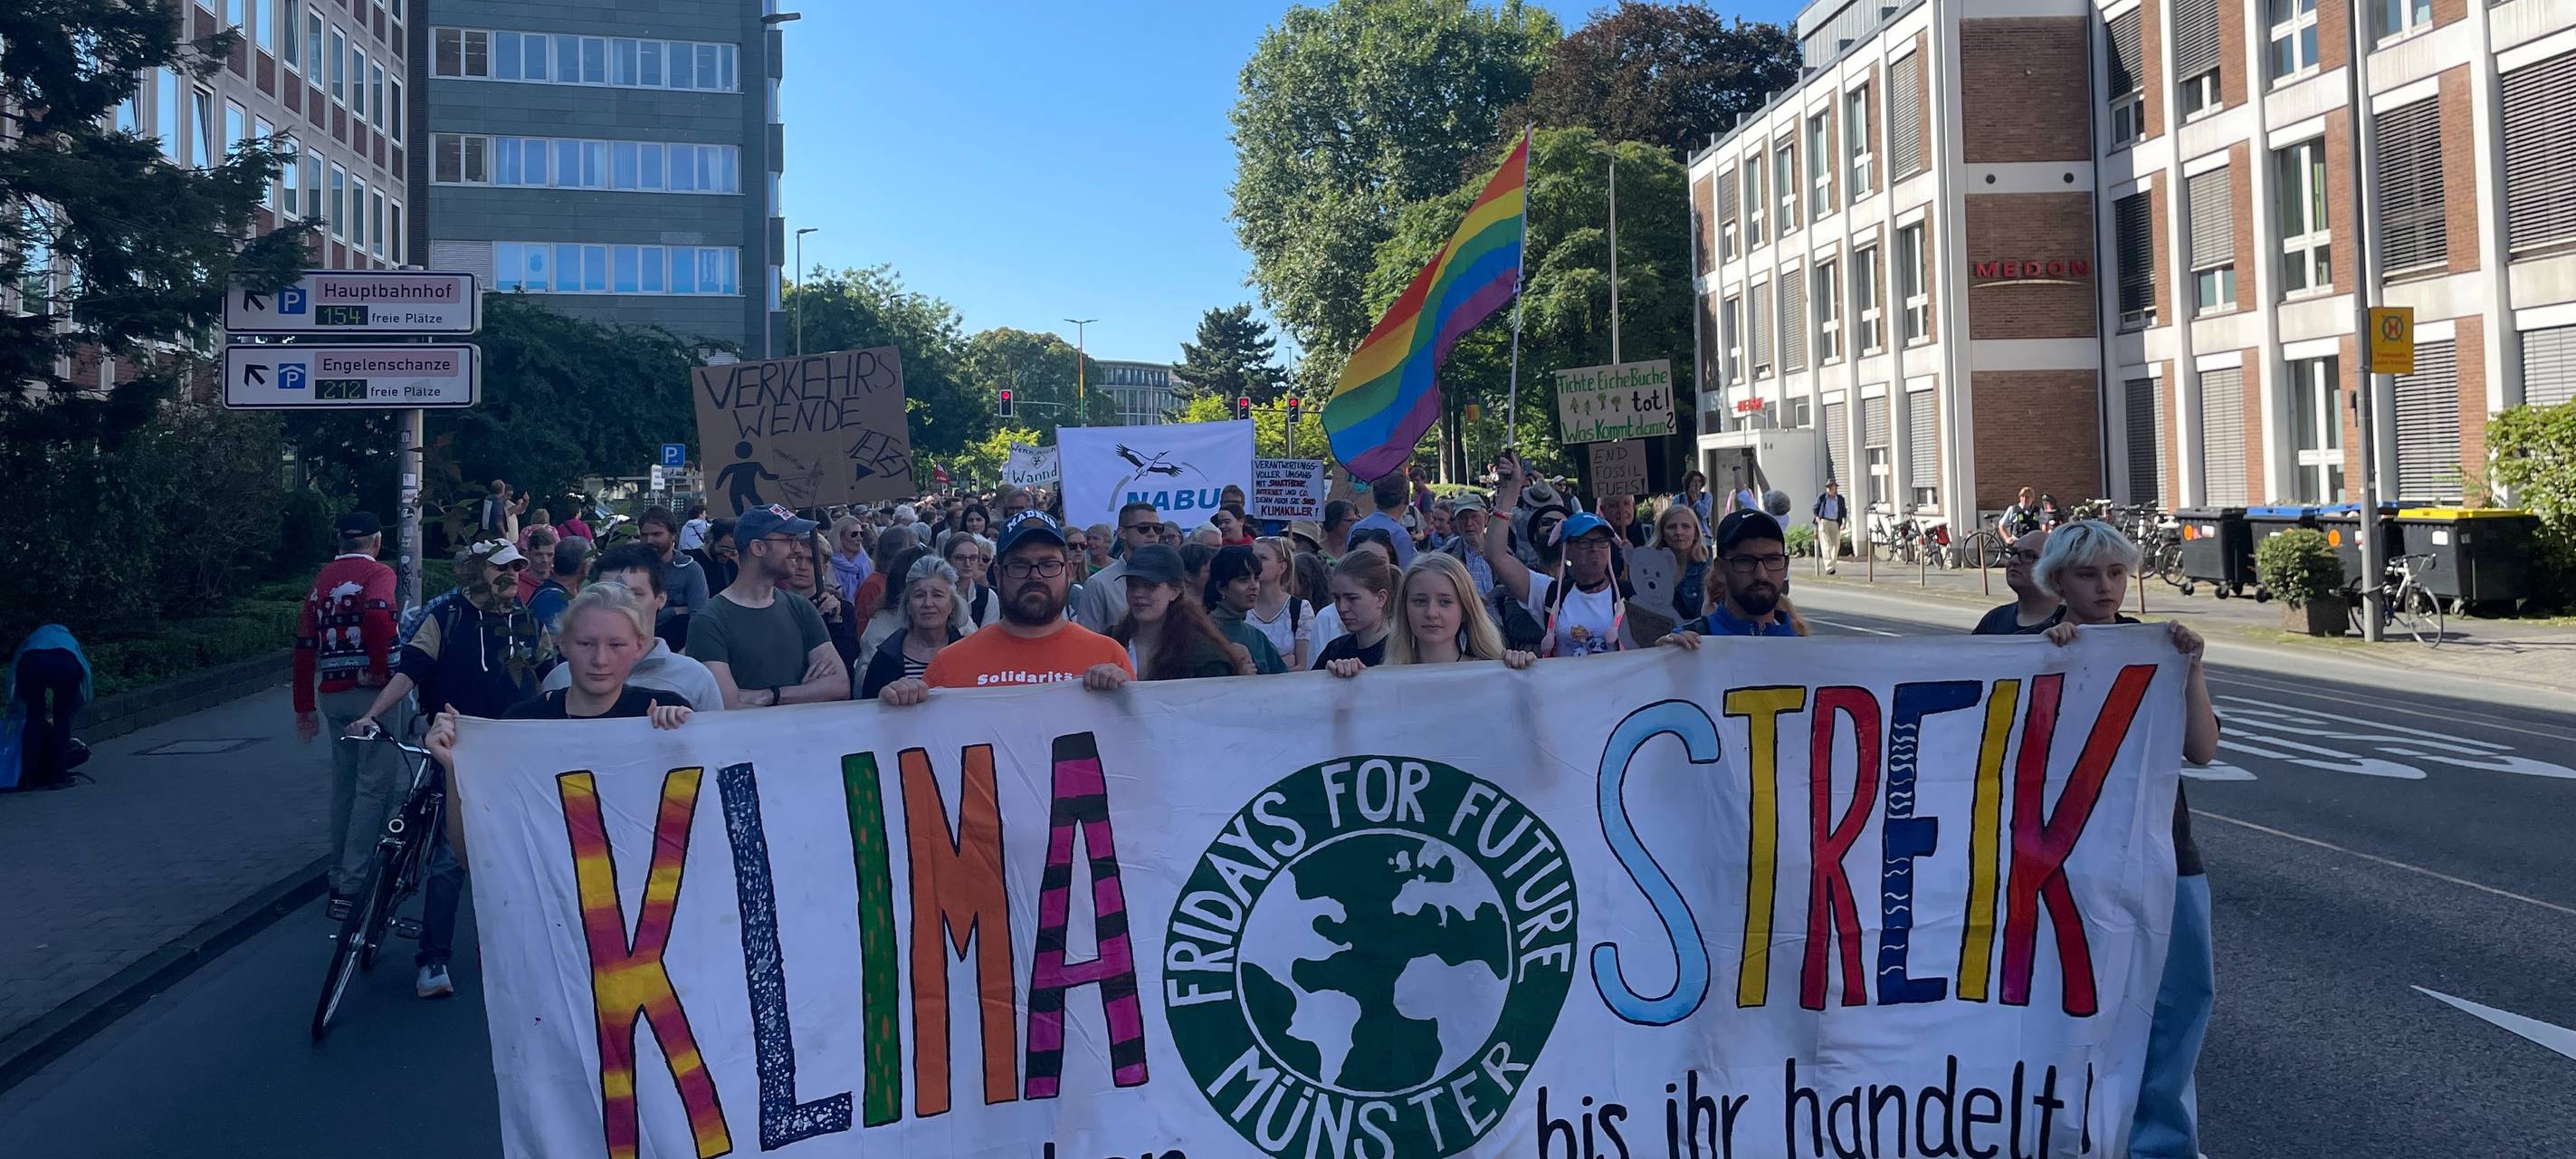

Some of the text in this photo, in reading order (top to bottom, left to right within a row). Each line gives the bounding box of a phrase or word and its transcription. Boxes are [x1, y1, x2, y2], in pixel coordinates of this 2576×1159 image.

[1976, 260, 2089, 278] MEDON
[324, 283, 452, 302] Hauptbahnhof
[324, 306, 443, 325] 154 freie Plätze
[323, 359, 451, 373] Engelenschanze
[1630, 366, 1667, 387] Buche
[323, 380, 361, 399] 212
[370, 387, 398, 397] freie
[701, 351, 896, 409] VERKEHRS
[1632, 387, 1671, 412] tot!
[732, 397, 862, 439] WENDE
[1562, 420, 1593, 443] Was
[1594, 447, 1628, 465] END
[1255, 471, 1312, 479] VOLLER UMGANG
[1596, 465, 1642, 479] FOSSIL
[1595, 478, 1646, 497] FUELS!
[1007, 510, 1057, 533] MADRID
[1166, 759, 1574, 1007] FRIDAYS FOR FUTURE
[556, 664, 2158, 1159] KLIMA STREIK
[1207, 1041, 1530, 1159] MÜNSTER
[1665, 1070, 1750, 1159] ihr
